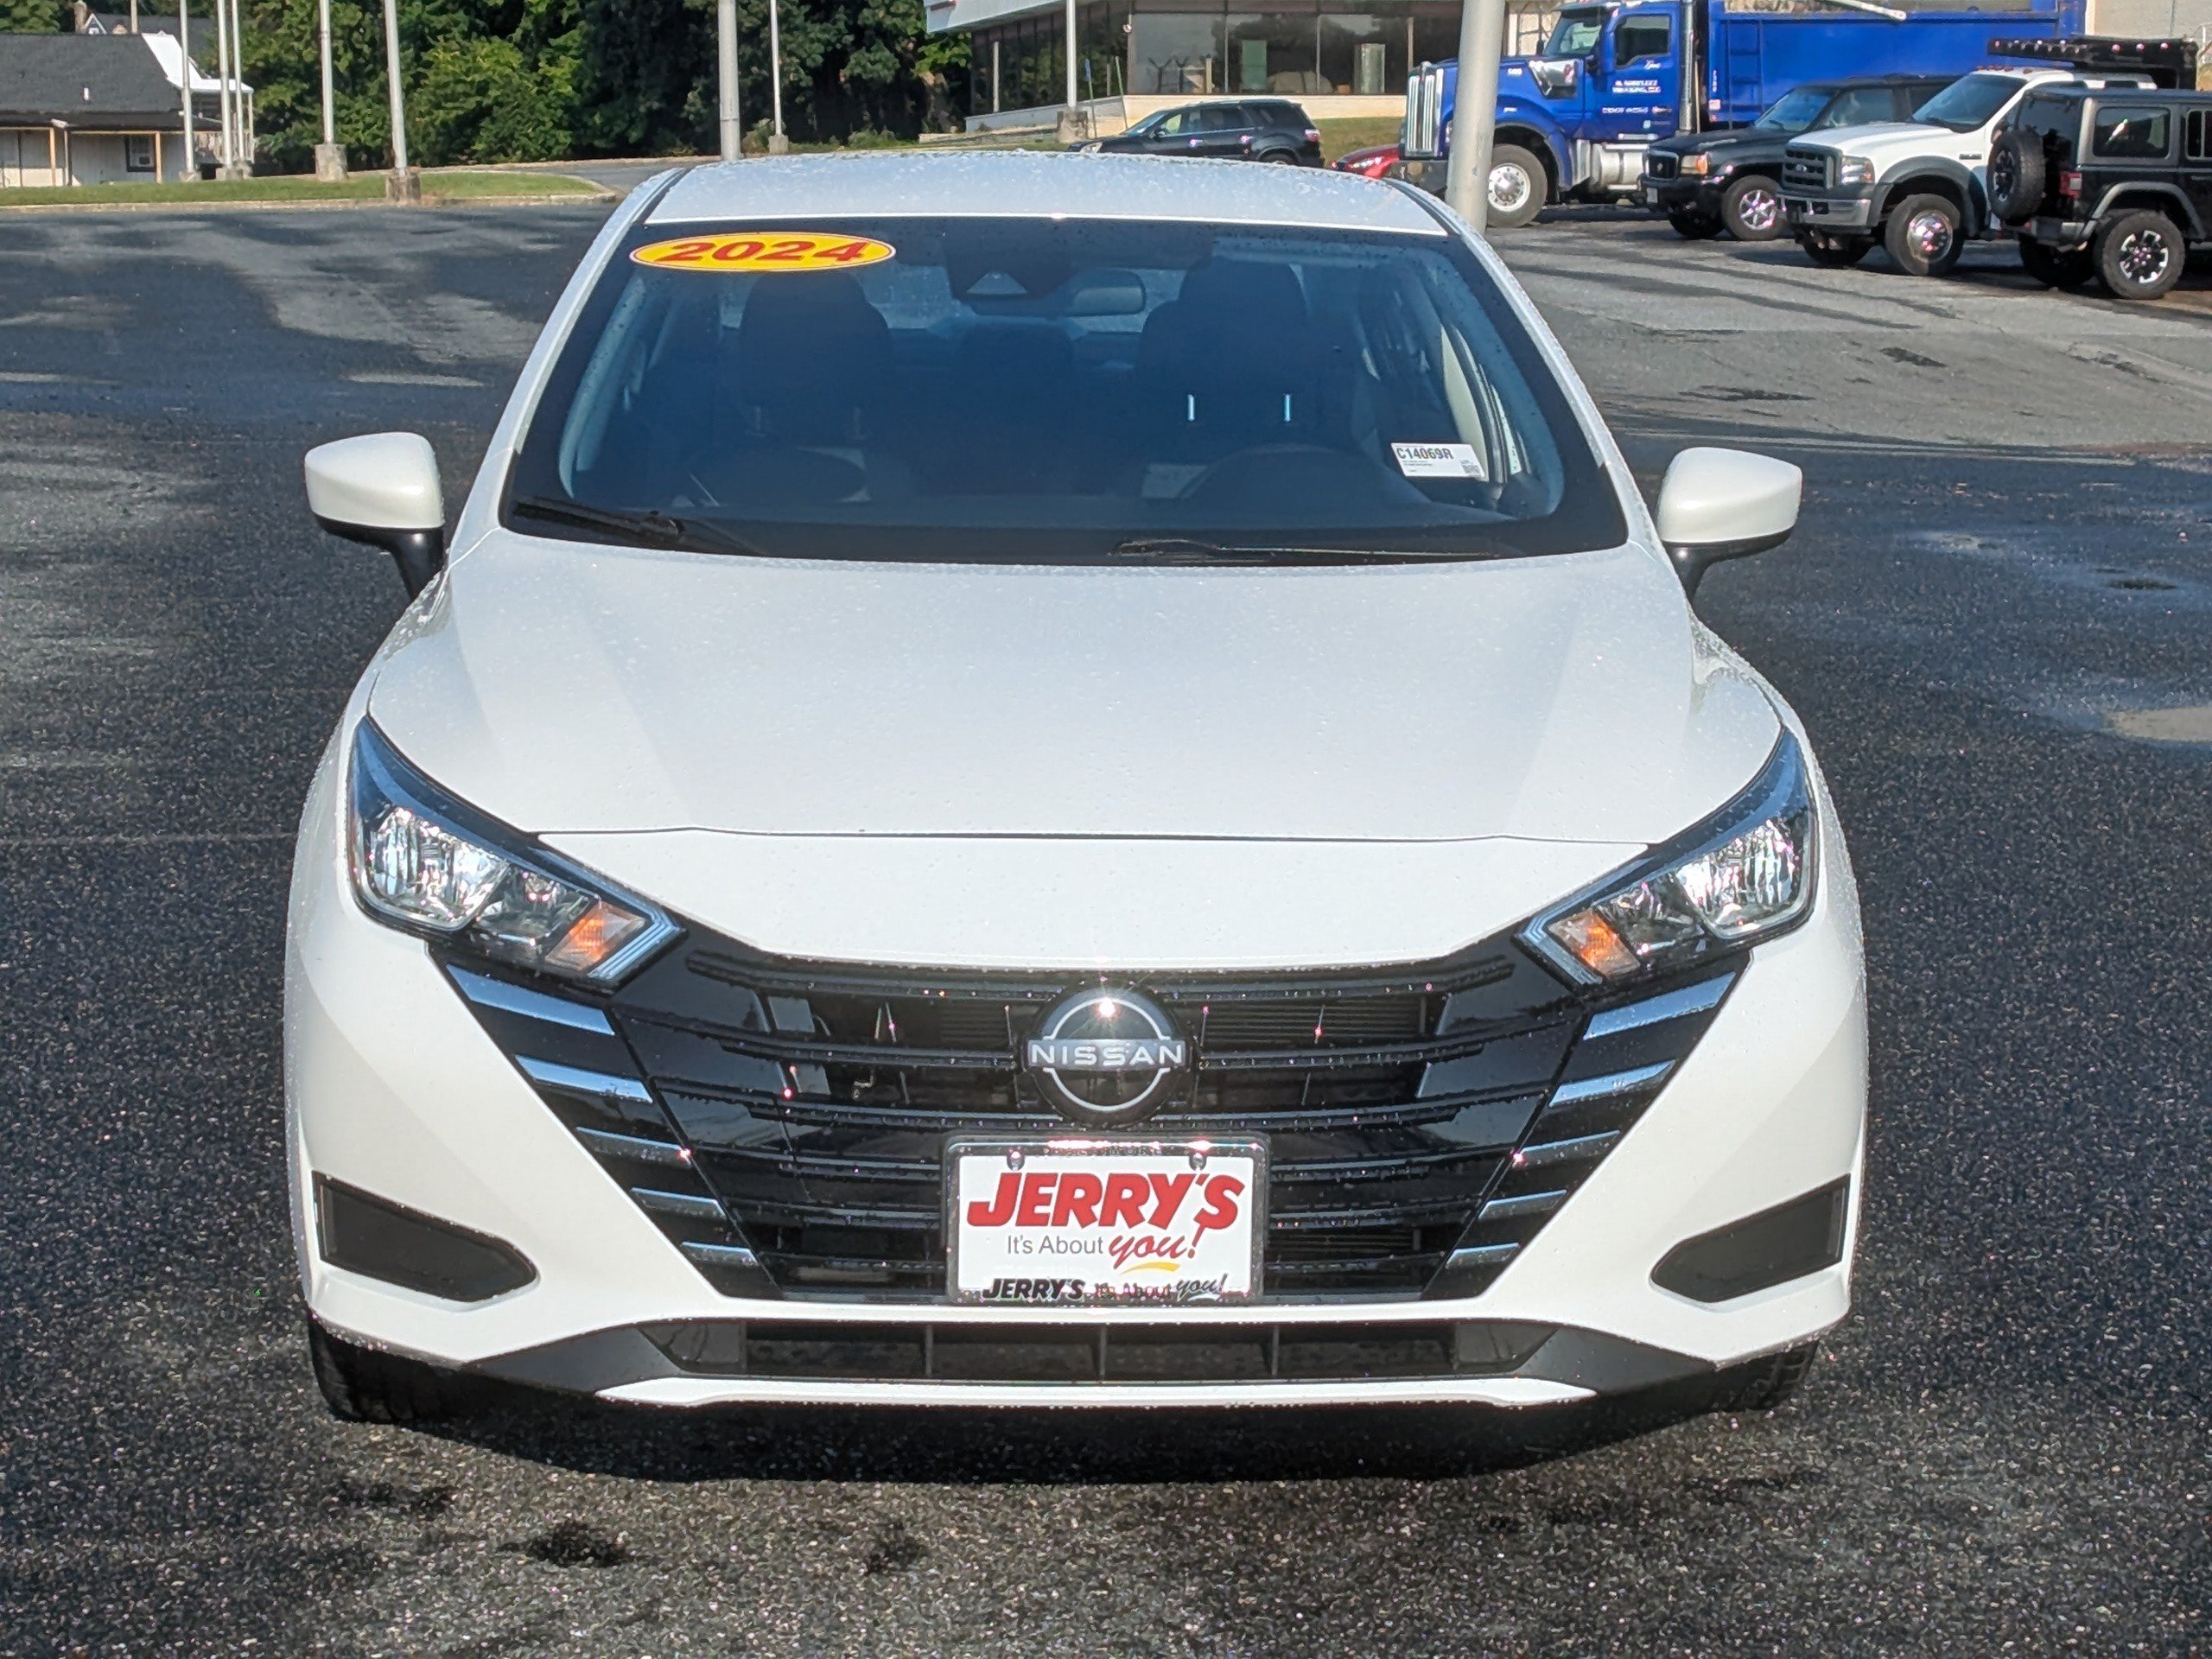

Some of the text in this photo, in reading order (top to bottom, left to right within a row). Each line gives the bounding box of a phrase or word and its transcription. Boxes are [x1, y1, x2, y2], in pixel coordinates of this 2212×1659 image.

[653, 240, 871, 262] 2024
[1396, 448, 1453, 459] C14069R
[1032, 1044, 1184, 1066] NISSAN
[966, 1172, 1246, 1230] JERRY'S
[1007, 1224, 1206, 1269] It's About you!
[982, 1277, 1086, 1300] JERRY'S
[1176, 1274, 1229, 1300] you!
